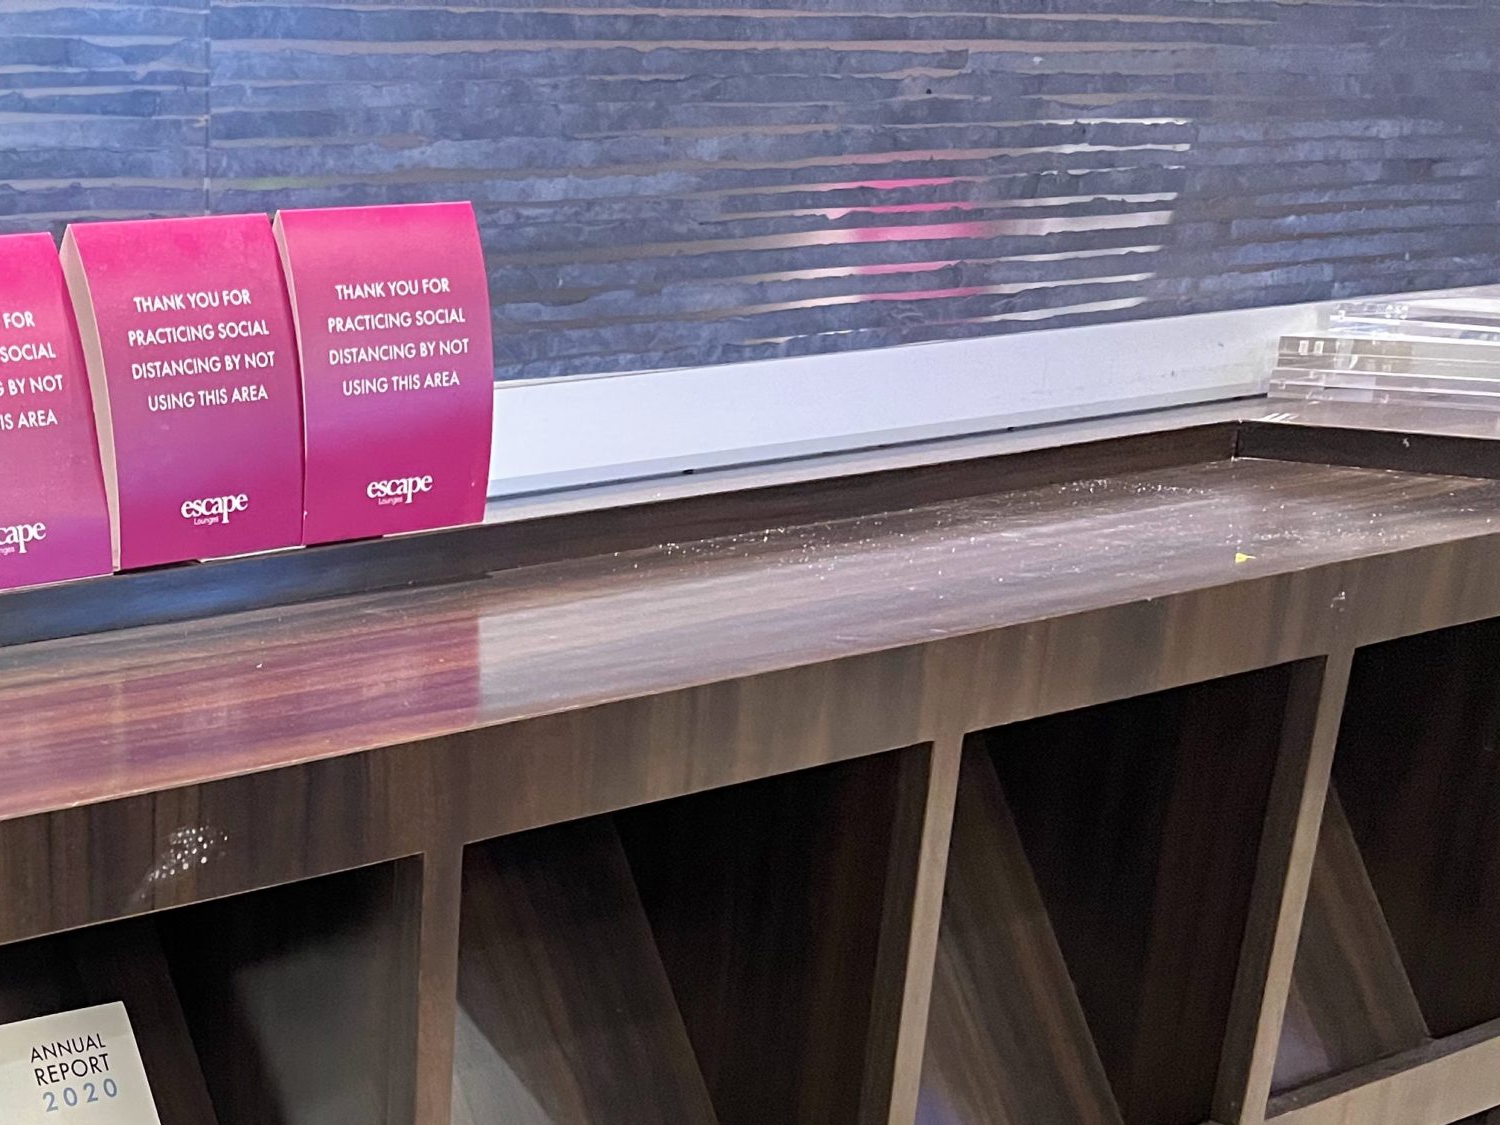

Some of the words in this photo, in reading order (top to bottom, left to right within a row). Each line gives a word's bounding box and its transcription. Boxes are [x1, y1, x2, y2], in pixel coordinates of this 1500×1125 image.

[133, 294, 186, 312] THANK
[187, 291, 219, 308] YOU
[222, 289, 251, 305] FOR
[335, 282, 385, 300] THANK
[387, 280, 418, 296] YOU
[422, 278, 450, 294] FOR
[3, 311, 35, 328] FOR
[328, 312, 412, 333] PRACTICING
[415, 308, 465, 326] SOCIAL
[128, 324, 215, 346] PRACTICING
[218, 320, 269, 339] SOCIAL
[0, 342, 56, 363] SOCIAL
[329, 343, 416, 365] DISTANCING
[420, 341, 435, 357] BY
[439, 338, 469, 355] NOT
[132, 356, 221, 380] DISTANCING
[225, 354, 241, 371] BY
[245, 351, 275, 368] NOT
[8, 378, 25, 396] BY
[30, 374, 62, 393] NOT
[343, 378, 388, 396] USING
[392, 374, 420, 391] THIS
[424, 370, 460, 388] AREA
[148, 392, 195, 411] USING
[198, 388, 228, 406] THIS
[232, 384, 268, 402] AREA
[18, 409, 58, 428] AREA
[367, 475, 432, 504] escape
[181, 493, 248, 524] escape
[31, 1033, 106, 1063] ANNUAL
[34, 1053, 108, 1086] REPORT
[43, 1078, 117, 1112] 2020
